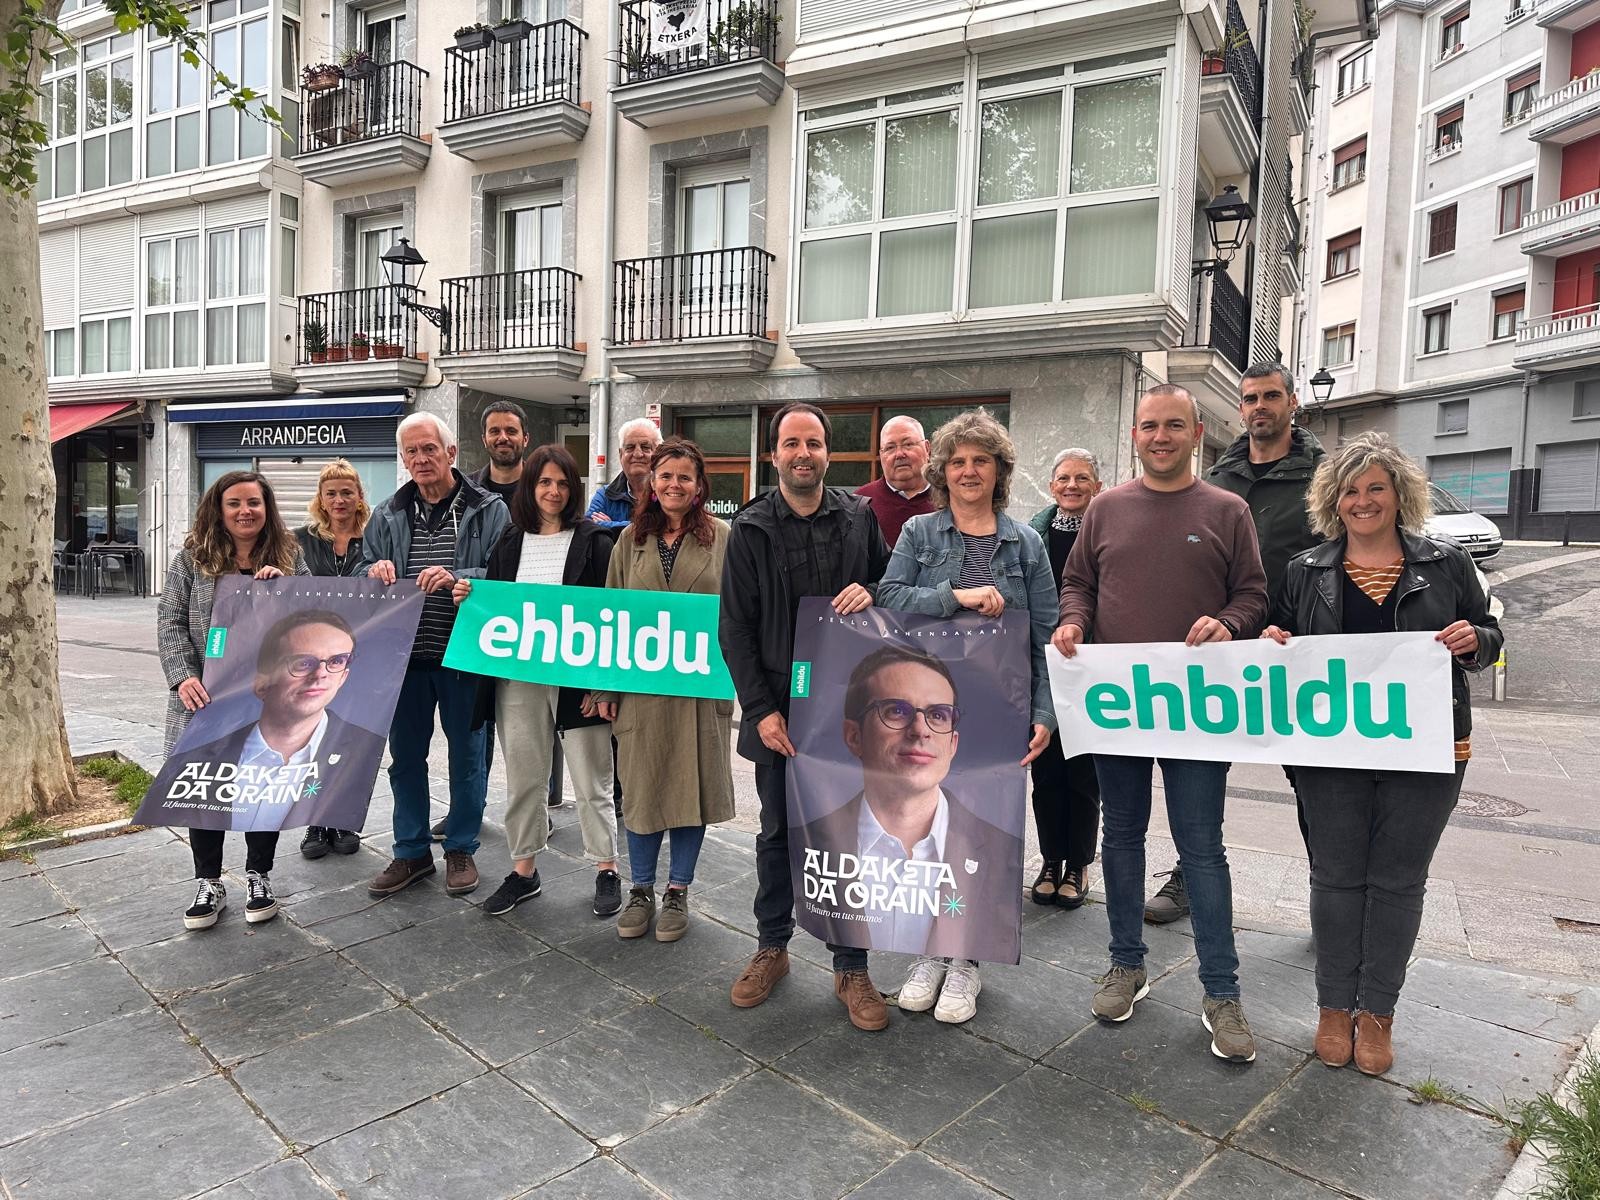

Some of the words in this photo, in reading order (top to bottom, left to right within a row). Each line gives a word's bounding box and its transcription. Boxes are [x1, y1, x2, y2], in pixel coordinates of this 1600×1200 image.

[658, 27, 697, 43] ETXERA
[240, 425, 346, 446] ARRANDEGIA
[296, 591, 406, 599] LEHENDAKARI
[818, 616, 868, 626] PELLO
[478, 601, 711, 675] ehbildu
[796, 665, 806, 694] ehbildu
[1084, 658, 1413, 740] ehbildu
[176, 761, 319, 785] ALDAKETA
[166, 780, 213, 800] DA
[215, 781, 305, 804] ORAIN
[170, 801, 197, 809] futuro
[803, 847, 958, 890] ALDAKETA
[803, 872, 838, 906] DA
[844, 881, 940, 917] ORAIN
[811, 903, 831, 917] futuro
[831, 911, 841, 919] en
[841, 912, 855, 920] tus
[855, 914, 883, 923] manos
